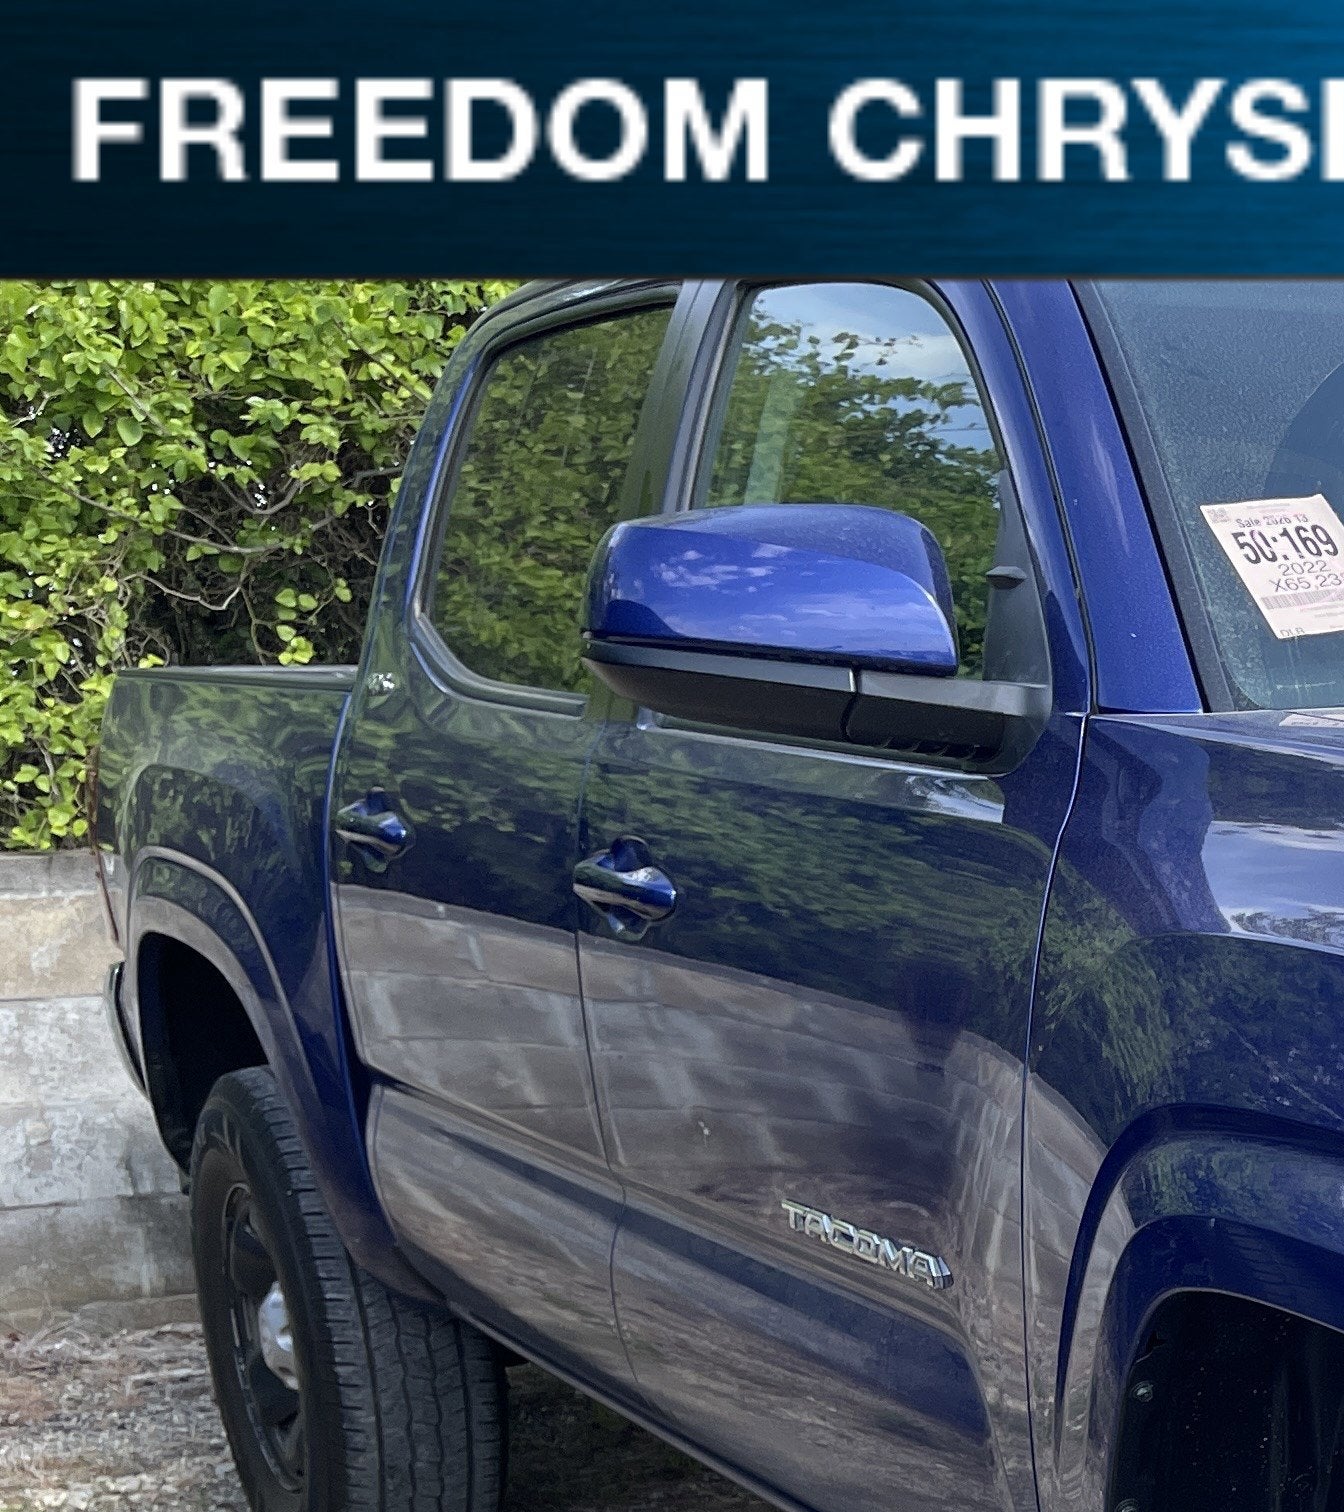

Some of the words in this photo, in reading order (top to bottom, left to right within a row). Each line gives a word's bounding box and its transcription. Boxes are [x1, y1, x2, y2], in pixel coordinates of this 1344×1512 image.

[1236, 517, 1261, 529] Sale
[1231, 524, 1339, 565] 50:169
[1278, 559, 1331, 577] 2022
[781, 1198, 954, 1290] TACOMA
